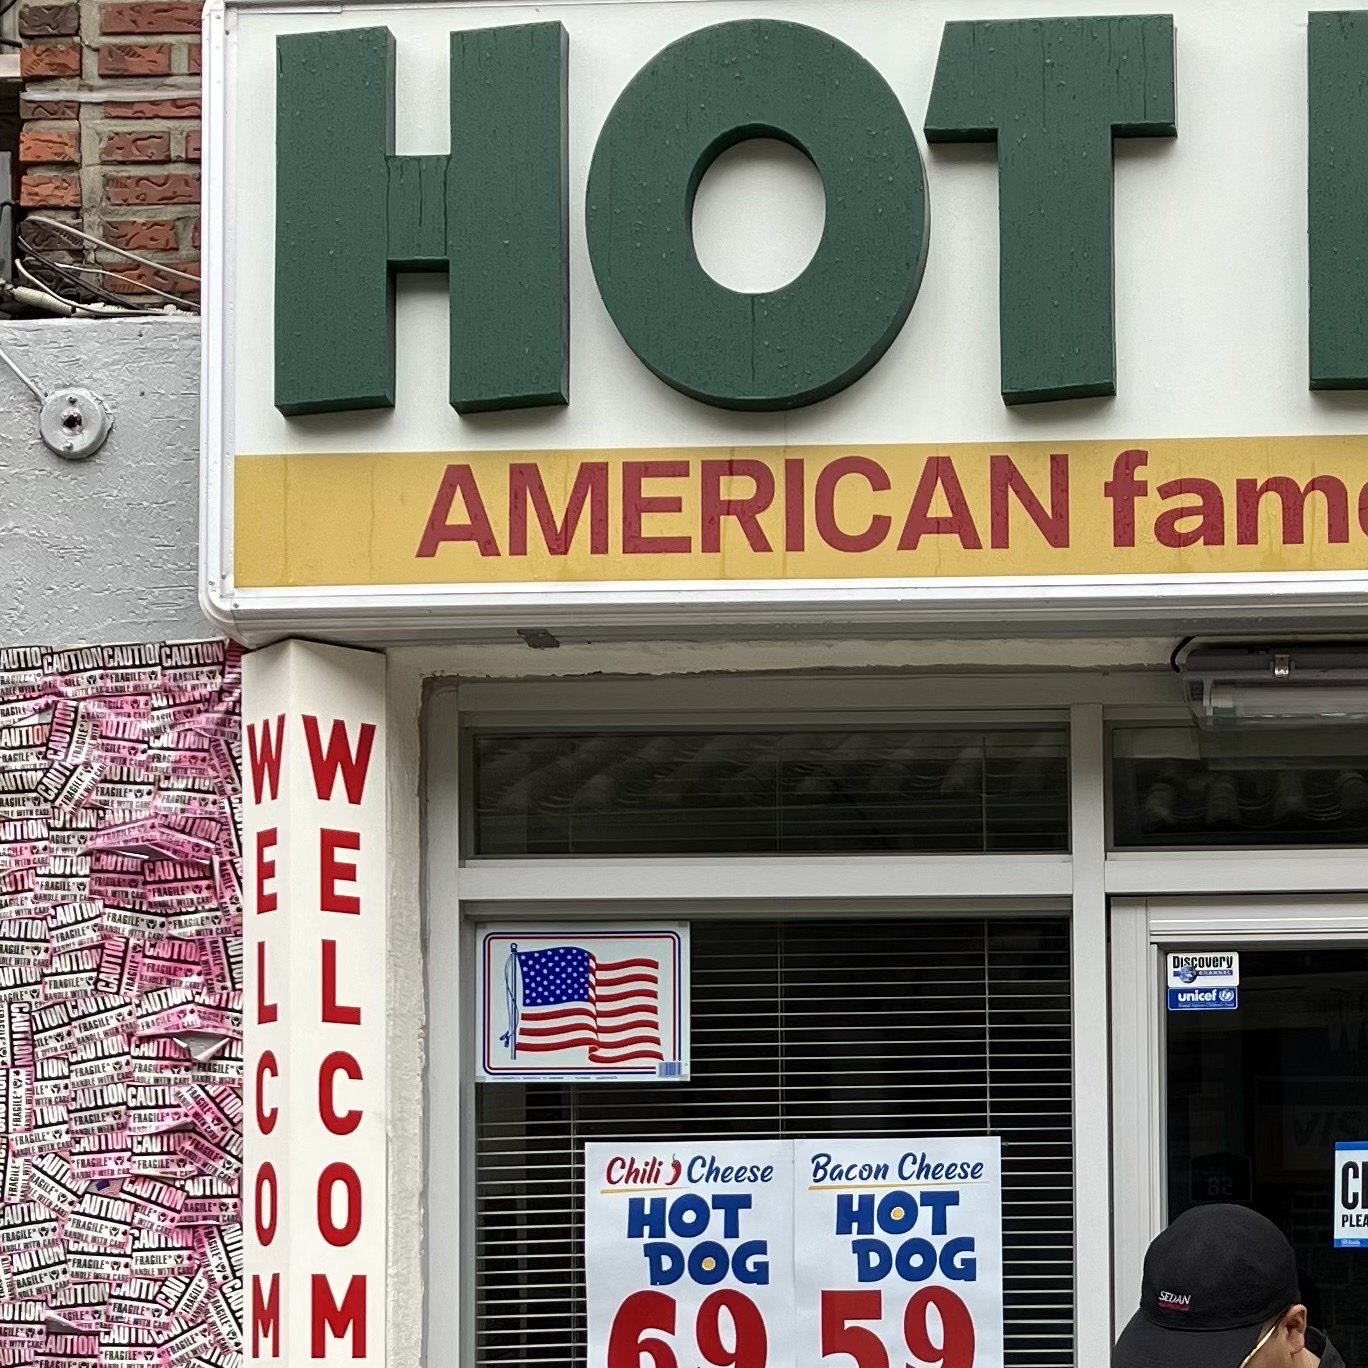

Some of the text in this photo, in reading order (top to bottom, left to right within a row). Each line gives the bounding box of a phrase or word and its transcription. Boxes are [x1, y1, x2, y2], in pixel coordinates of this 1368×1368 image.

[276, 14, 1177, 416] HOT
[415, 453, 1070, 560] AMERICAN
[43, 647, 103, 675] CAUTION
[161, 641, 225, 668] CAUTION
[1173, 956, 1233, 968] Discovery
[1178, 989, 1217, 1001] unicef
[605, 1154, 773, 1186] Chili Cheese
[811, 1151, 984, 1182] Bacon Cheese
[627, 1193, 752, 1238] HOT
[835, 1190, 960, 1236] HOT
[644, 1240, 769, 1286] DOG
[852, 1237, 977, 1282] DOG
[1158, 1290, 1191, 1305] SEDAN
